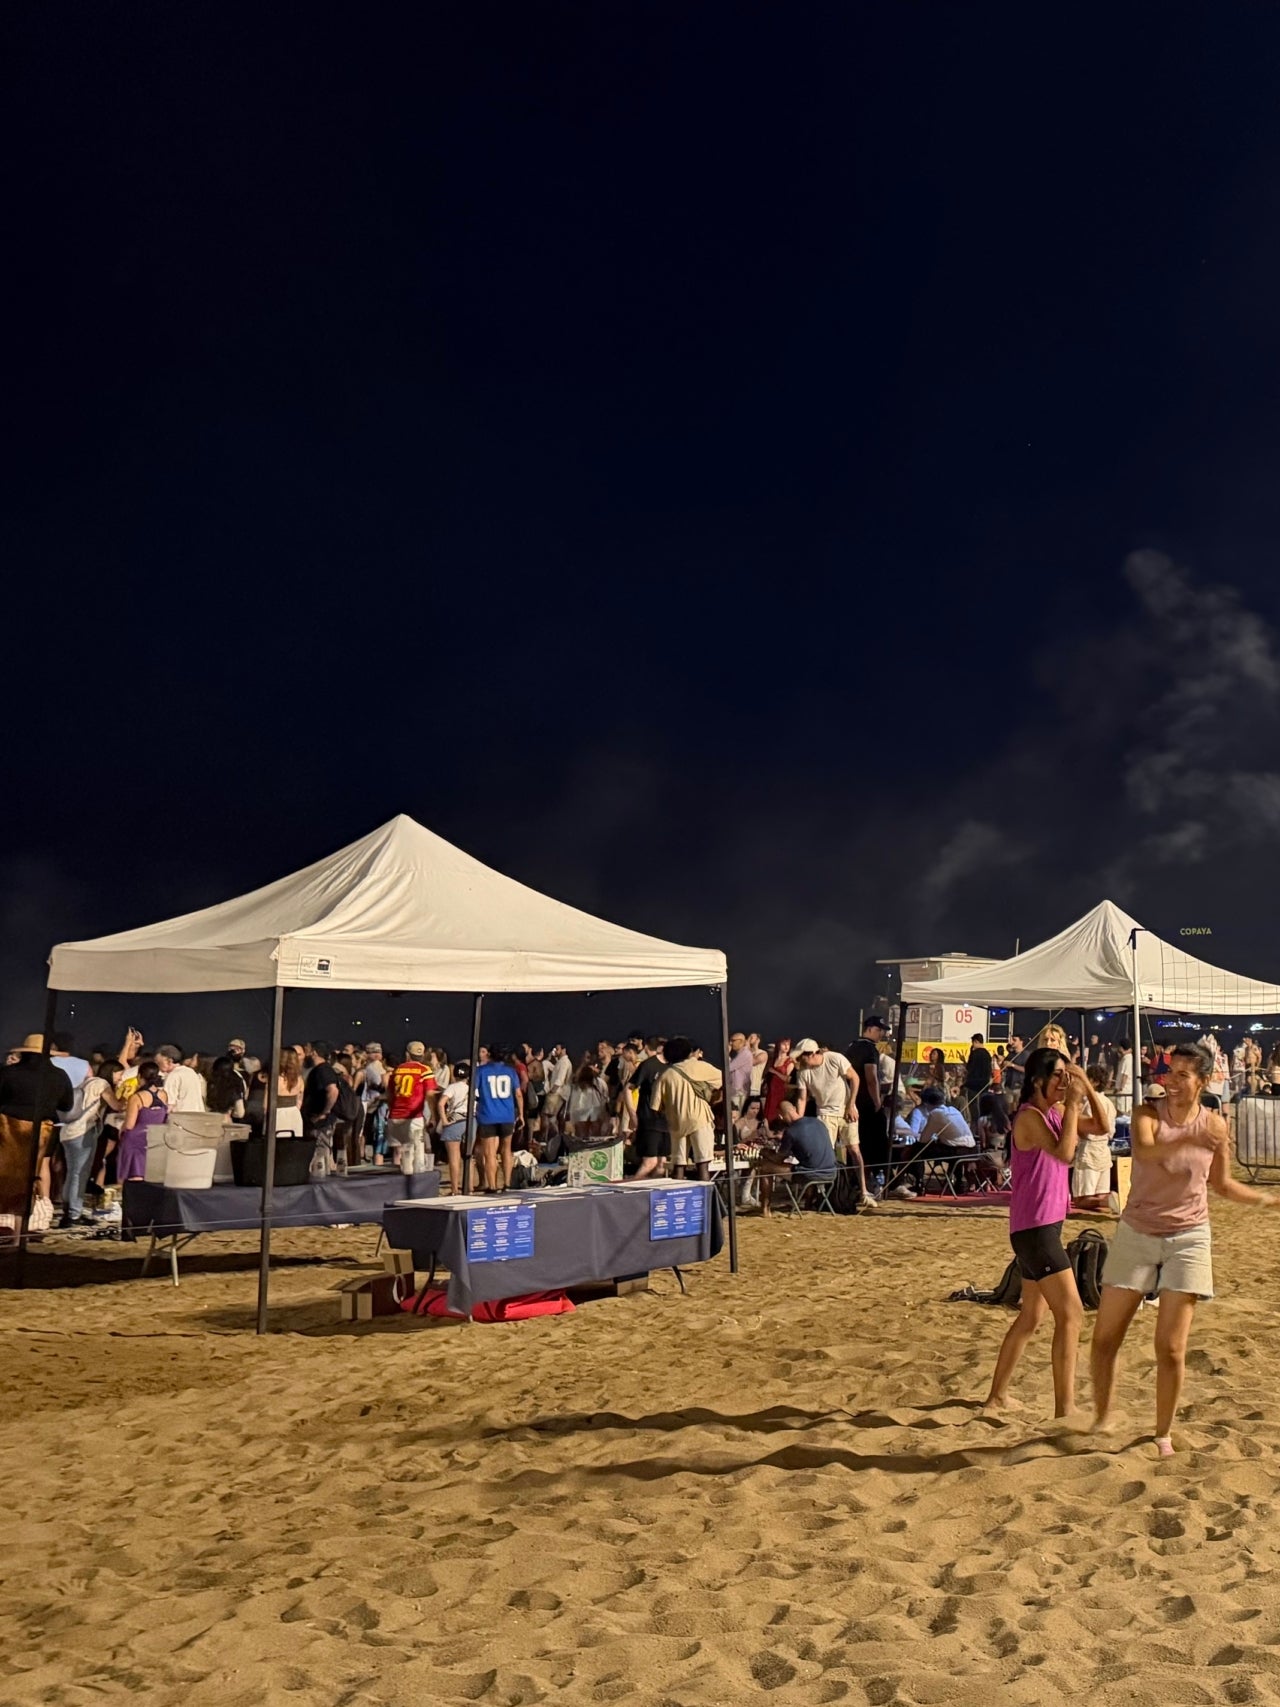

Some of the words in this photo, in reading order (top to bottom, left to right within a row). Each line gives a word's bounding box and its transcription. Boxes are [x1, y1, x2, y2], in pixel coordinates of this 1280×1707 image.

[1179, 927, 1213, 936] COPAYA
[955, 1009, 973, 1024] 05
[487, 1074, 512, 1099] 10
